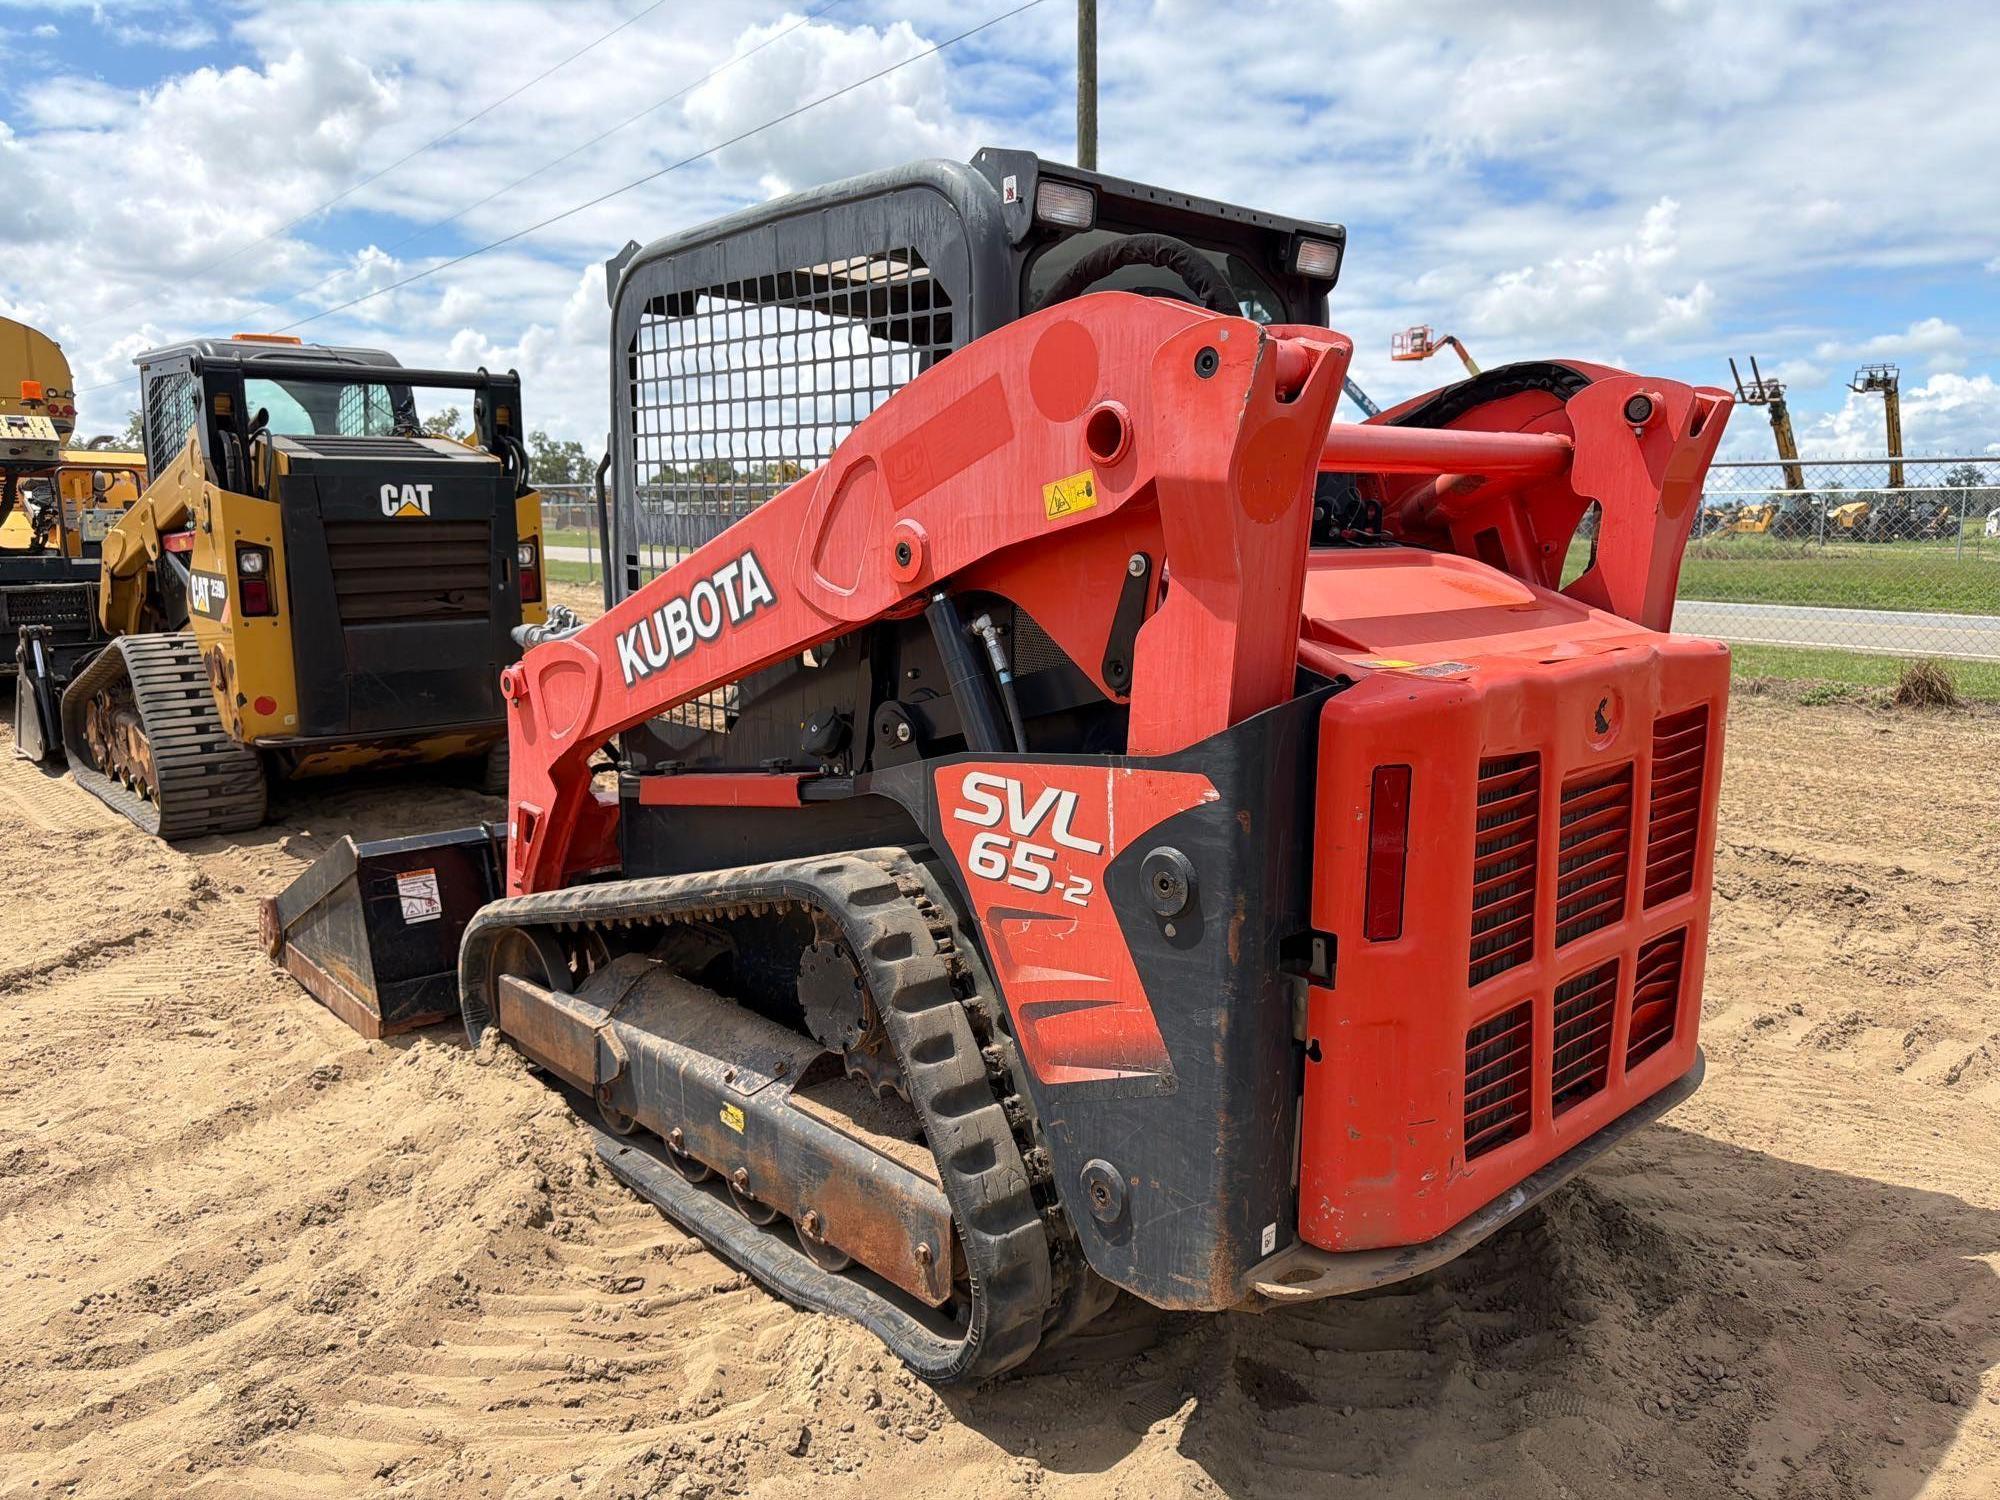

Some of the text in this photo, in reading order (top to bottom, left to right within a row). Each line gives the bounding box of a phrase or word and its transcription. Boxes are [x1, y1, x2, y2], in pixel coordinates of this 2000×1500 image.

[380, 483, 433, 517] CAT
[191, 574, 210, 613] CAT
[615, 551, 774, 686] KUBOTA
[953, 770, 1105, 856] SVL
